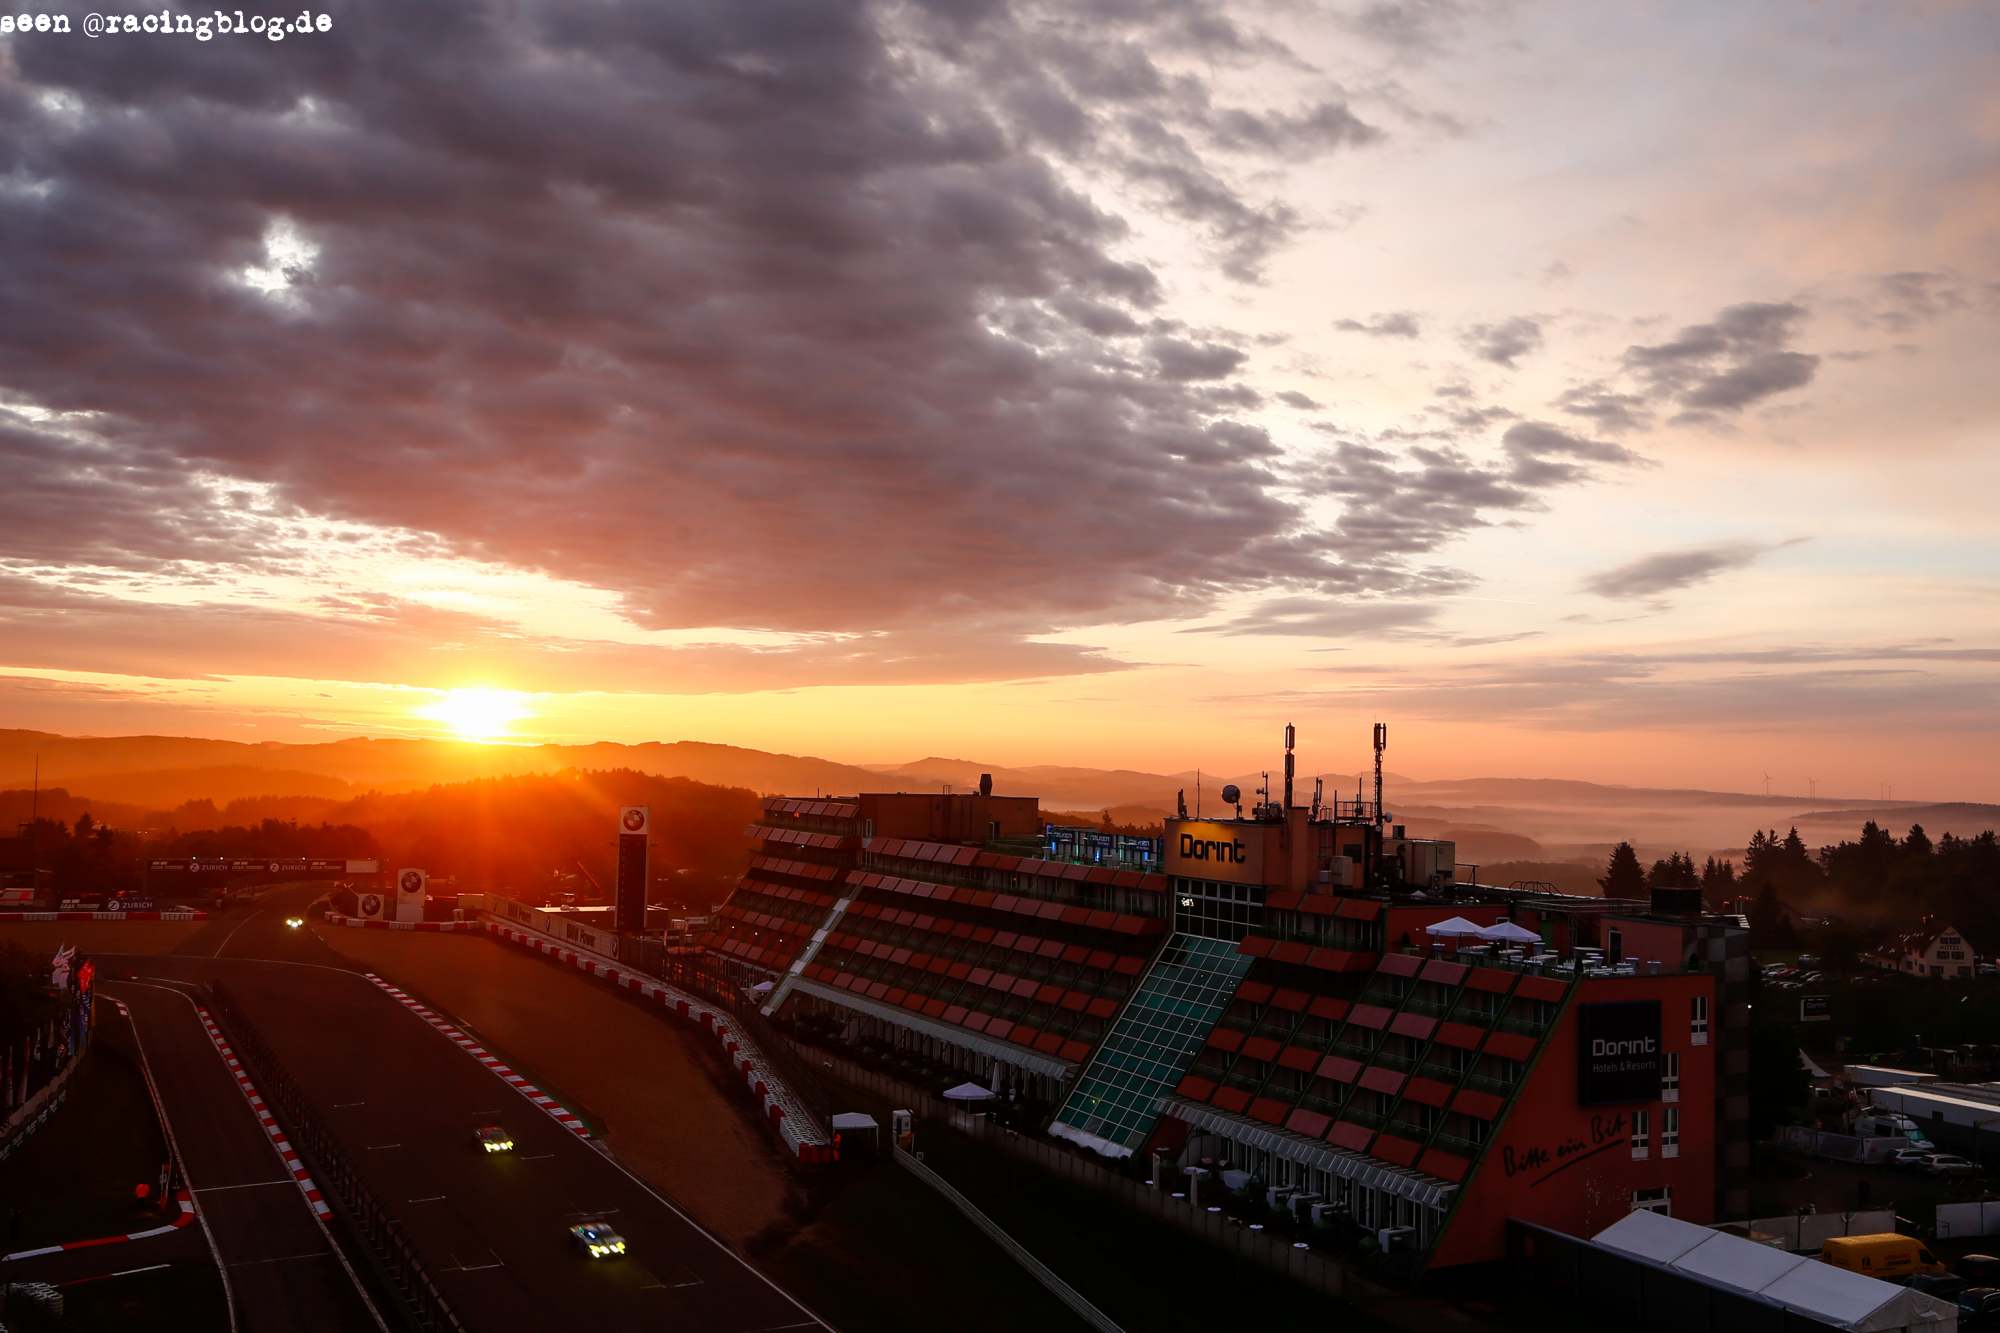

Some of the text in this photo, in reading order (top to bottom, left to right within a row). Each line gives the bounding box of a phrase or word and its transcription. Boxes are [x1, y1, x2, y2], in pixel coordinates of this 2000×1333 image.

[1180, 833, 1245, 864] Dorint
[122, 902, 153, 910] ZURICH
[1592, 1036, 1656, 1056] Dorint
[1503, 1112, 1627, 1178] Bitte ein Bit
